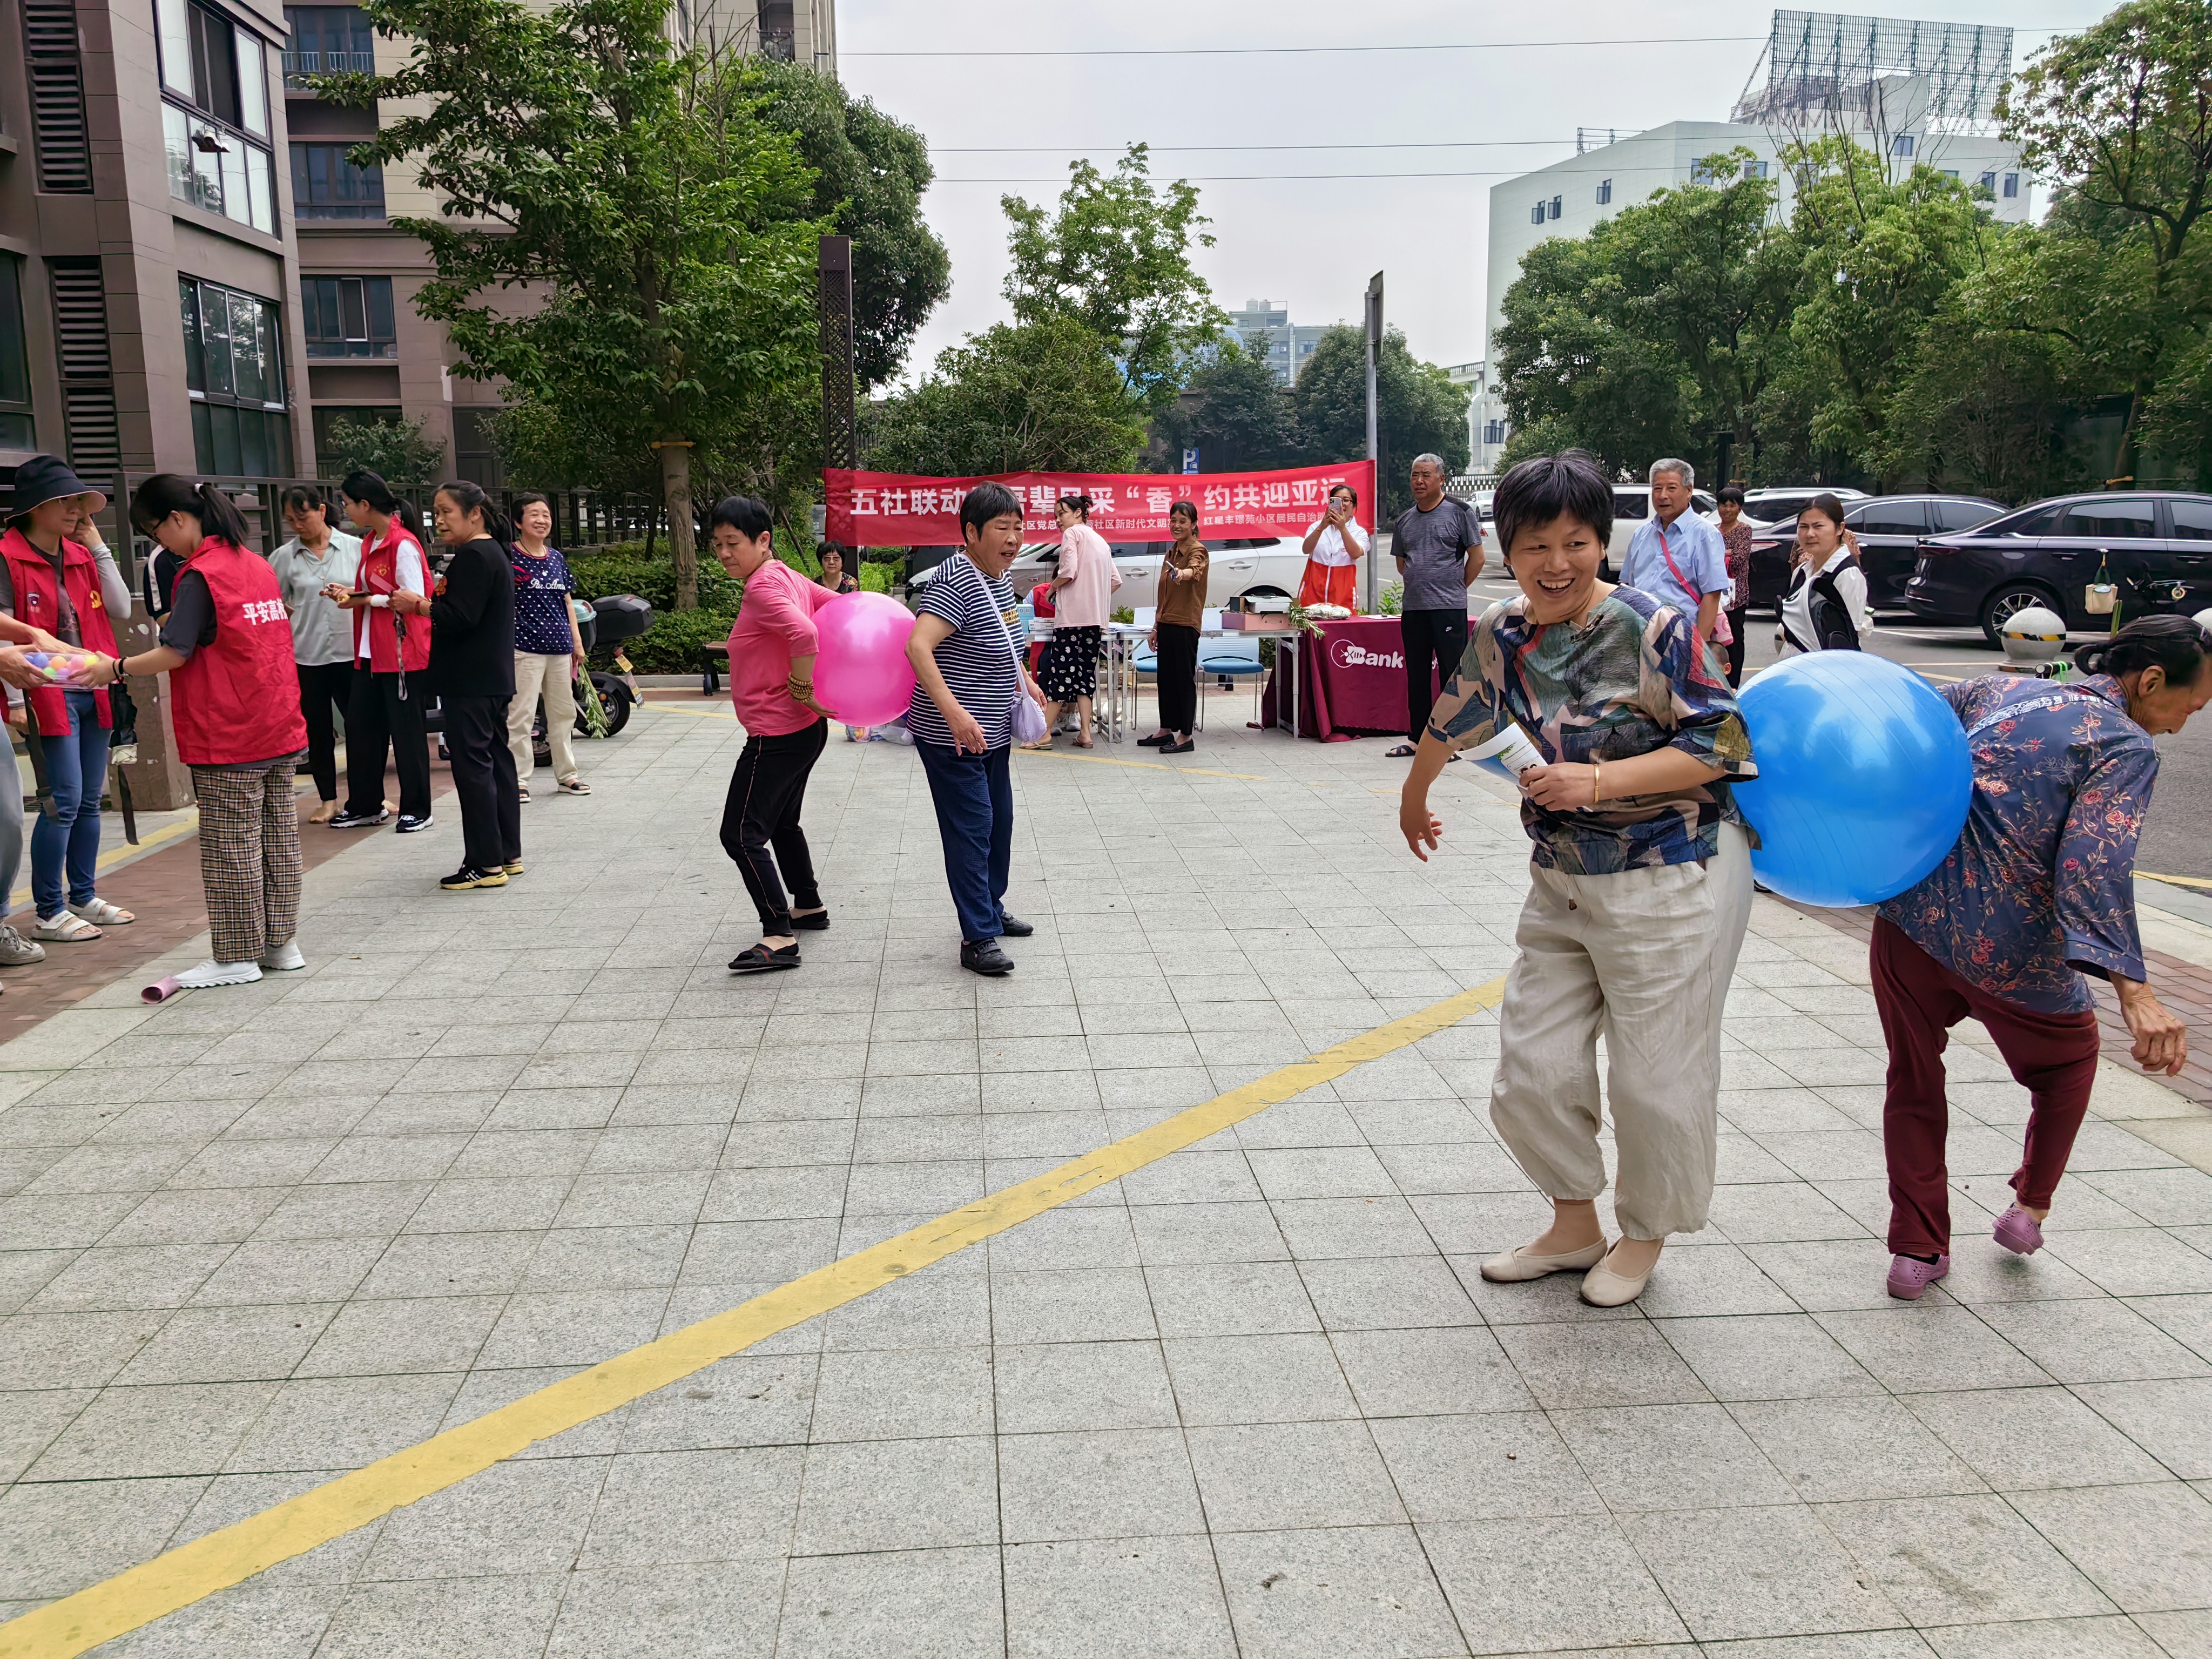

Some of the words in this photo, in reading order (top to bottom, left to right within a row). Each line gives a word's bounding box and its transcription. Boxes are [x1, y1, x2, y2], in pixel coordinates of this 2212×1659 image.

[1183, 449, 1196, 469] P
[1085, 518, 1170, 530] 社区新时代文明
